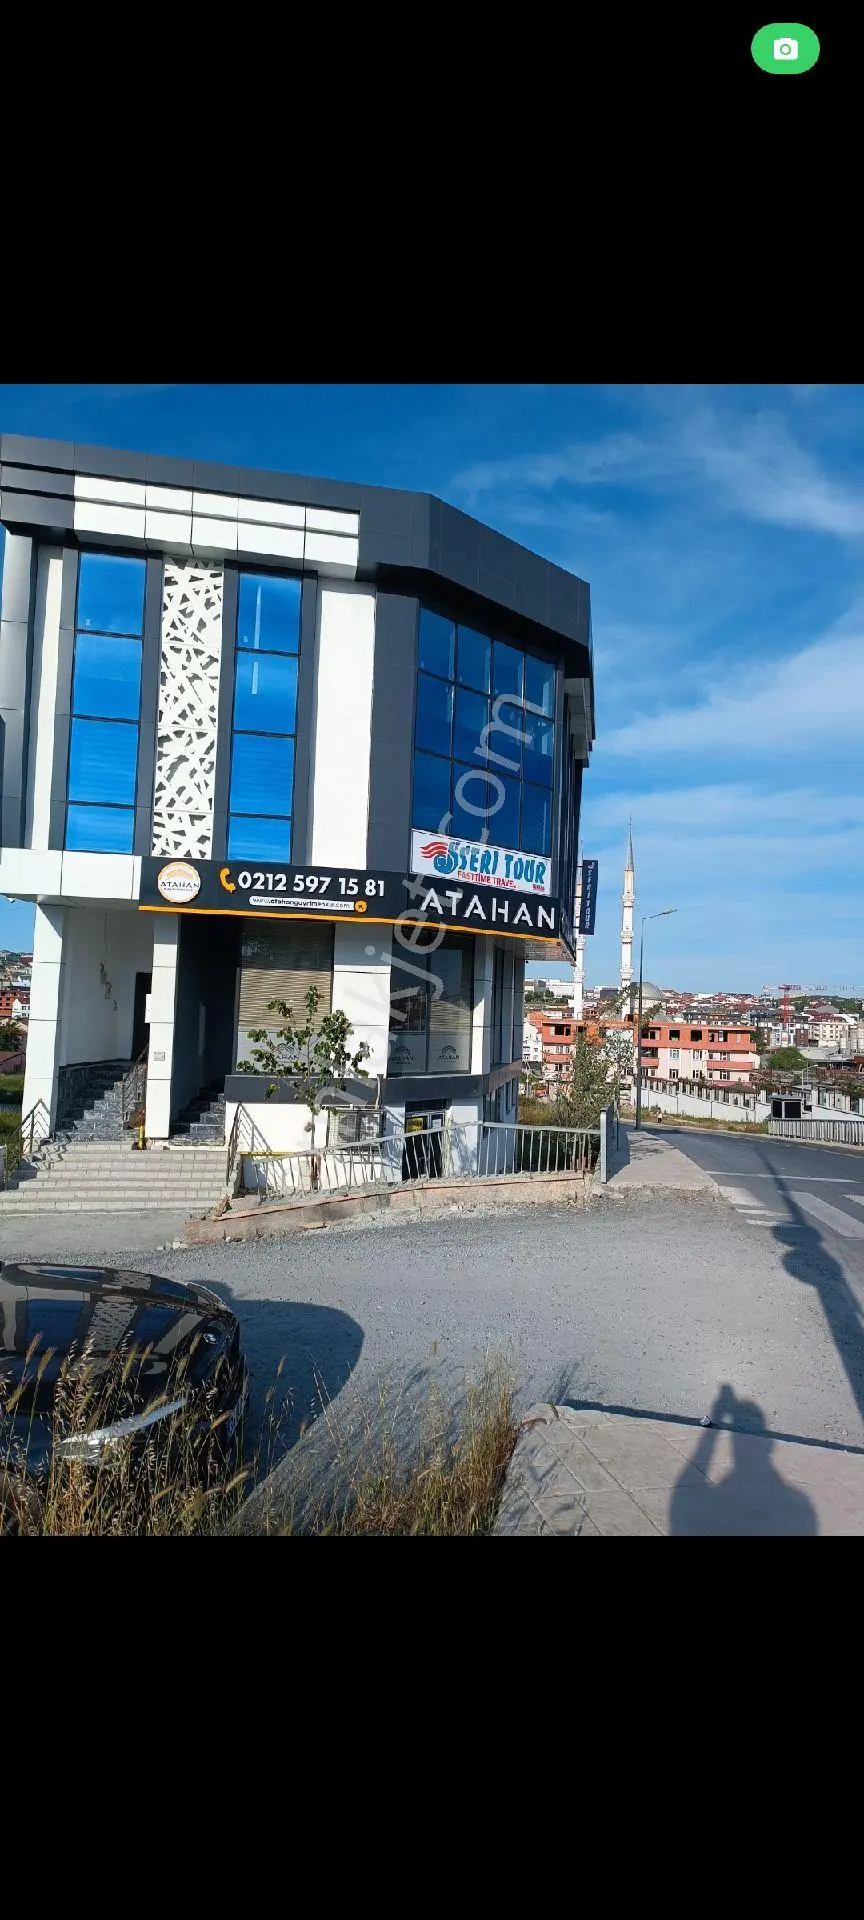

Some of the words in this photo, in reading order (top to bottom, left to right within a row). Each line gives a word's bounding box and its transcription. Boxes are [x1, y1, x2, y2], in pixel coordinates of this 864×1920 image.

[504, 853, 547, 884] TOUR
[160, 881, 200, 889] ATAHAN
[237, 871, 287, 891] 0212
[292, 874, 332, 894] 597
[338, 877, 359, 896] 15
[364, 879, 385, 897] 81
[493, 876, 517, 889] TRAVEL
[420, 888, 555, 930] ATAHAN
